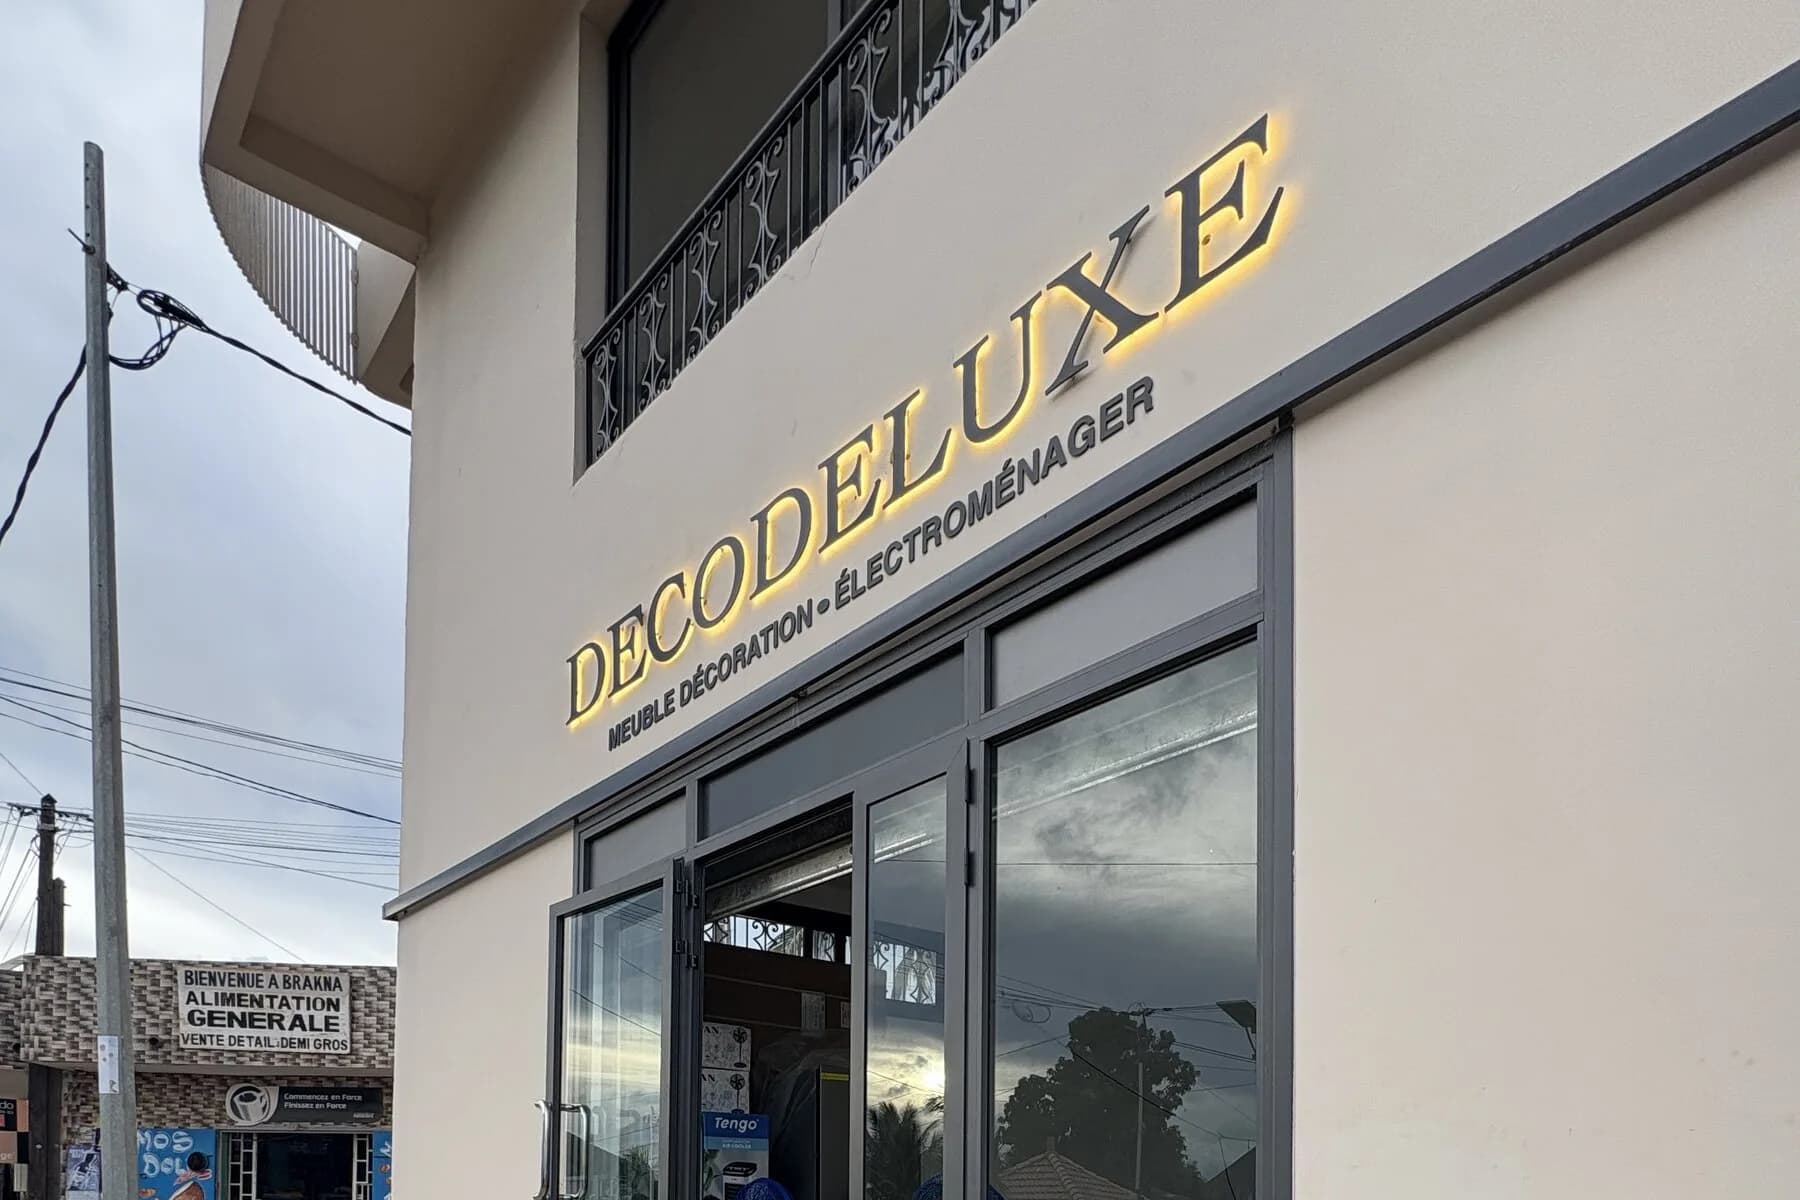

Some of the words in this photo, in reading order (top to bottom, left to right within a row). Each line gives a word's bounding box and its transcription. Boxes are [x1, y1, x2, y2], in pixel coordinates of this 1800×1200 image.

[565, 113, 1285, 728] DECODELUXE
[608, 688, 676, 752] MEUBLE
[679, 598, 814, 708] DÉCORATION
[834, 375, 1155, 611] ÉLECTROMÉNAGER
[184, 970, 265, 989] BIENVENUE
[268, 972, 280, 989] A
[282, 974, 344, 993] BRAKNA
[185, 990, 341, 1013] ALIMENTATION
[187, 1009, 341, 1033] GENERALE
[181, 1033, 225, 1047] VENTE
[280, 1037, 310, 1050] DEMI
[313, 1038, 349, 1051] GROS
[715, 1117, 757, 1133] Tengo
